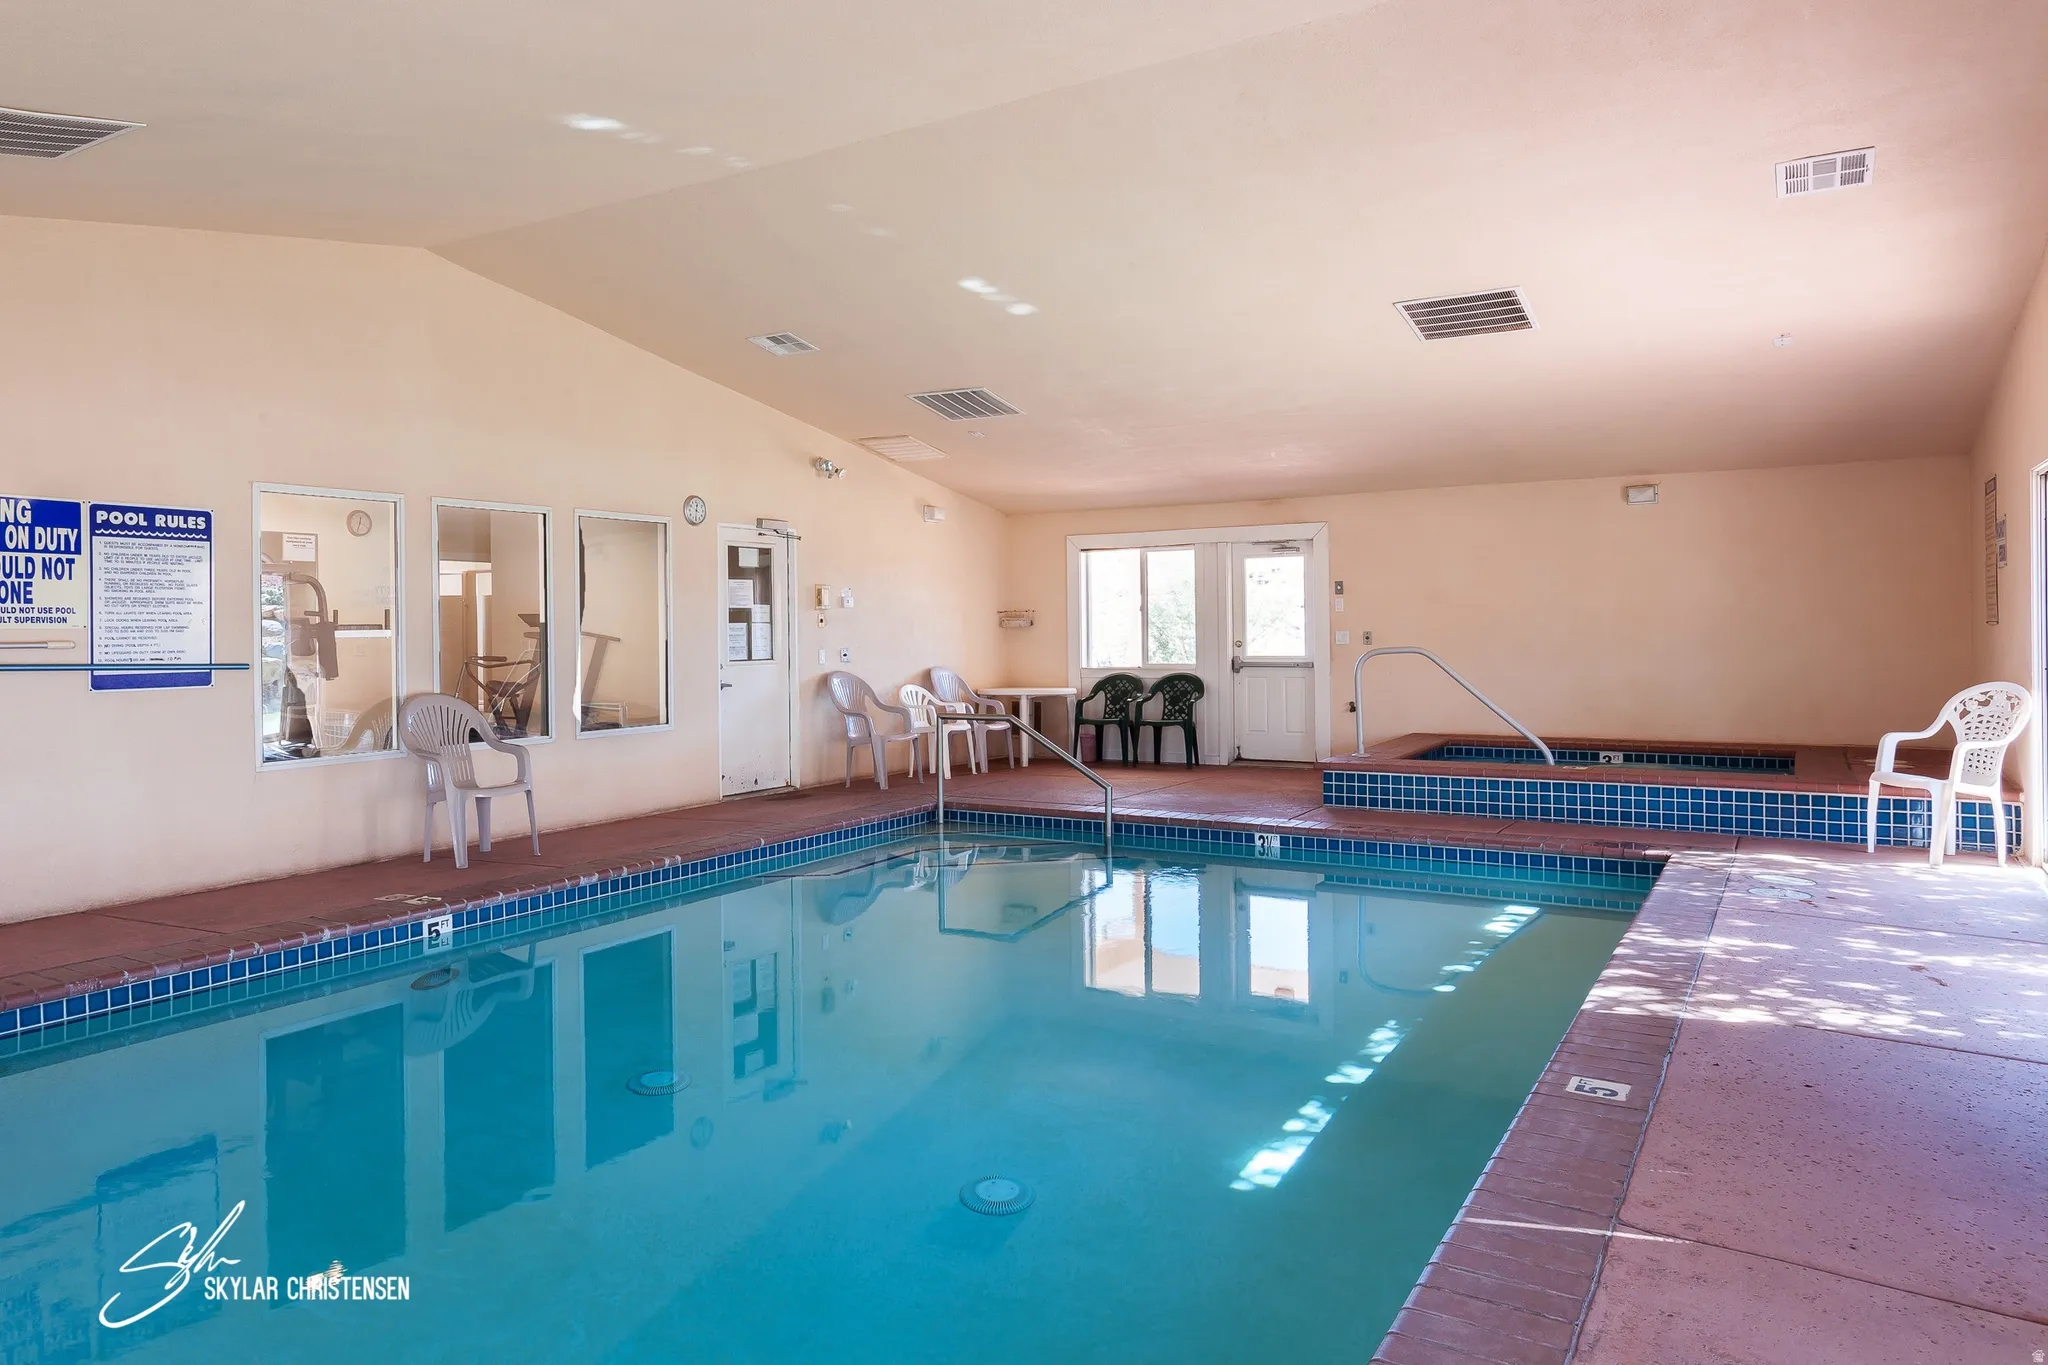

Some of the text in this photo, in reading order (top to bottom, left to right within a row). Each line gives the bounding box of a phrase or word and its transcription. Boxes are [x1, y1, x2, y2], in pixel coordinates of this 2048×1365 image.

[0, 499, 32, 524] NG
[96, 510, 206, 529] POOL RULES
[5, 525, 78, 551] ON DUTY
[0, 556, 75, 580] ULD NOT
[0, 580, 33, 604] ONE
[428, 919, 450, 938] 5 FT
[1574, 1084, 1618, 1097] 5
